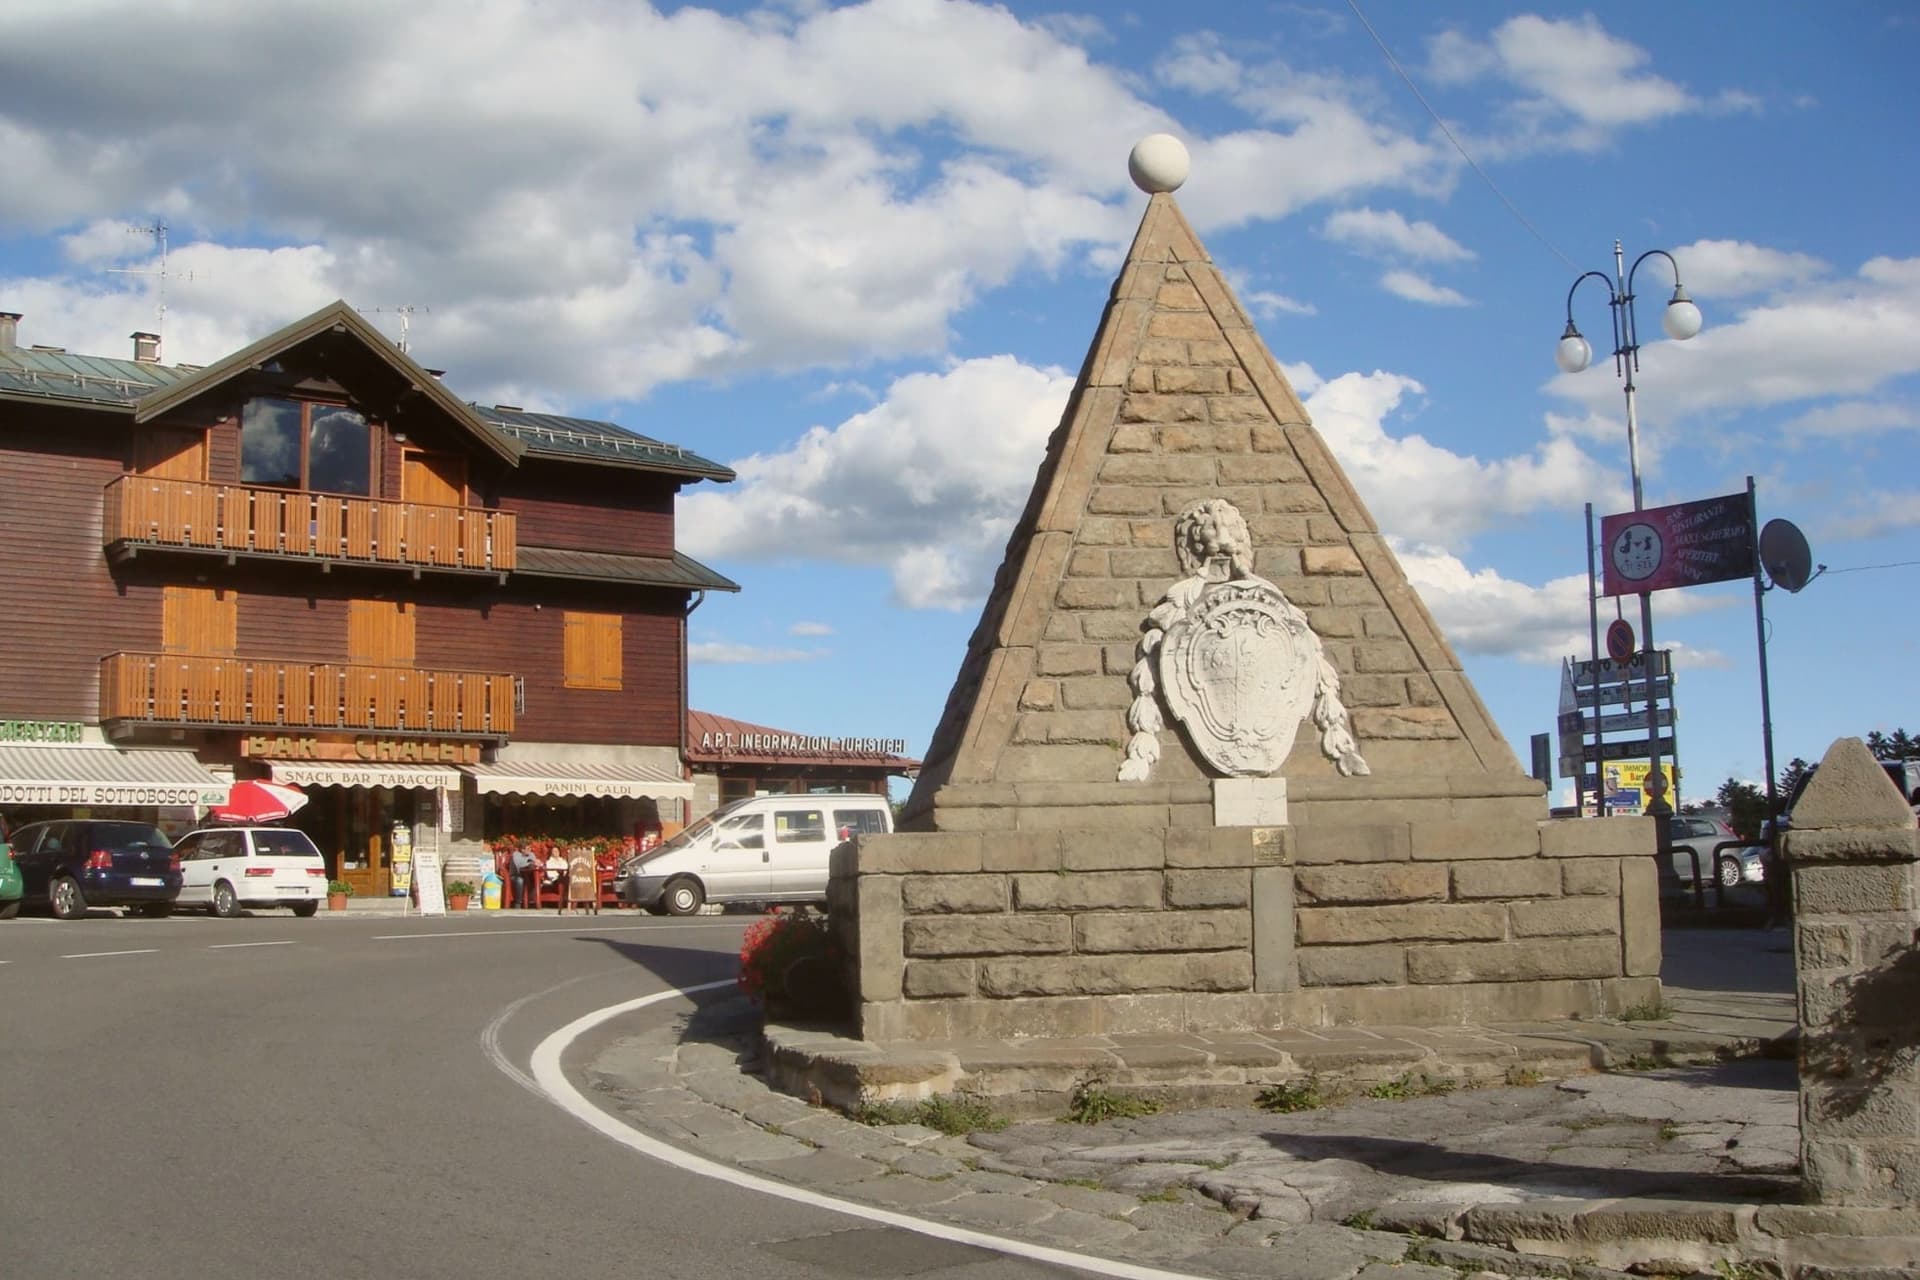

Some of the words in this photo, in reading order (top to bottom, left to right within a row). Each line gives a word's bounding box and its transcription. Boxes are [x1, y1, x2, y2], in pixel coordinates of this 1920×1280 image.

[249, 736, 318, 758] BAR
[285, 770, 334, 784] SNACK
[342, 771, 371, 784] BAR
[380, 773, 449, 786] TABACCHI
[0, 786, 52, 803] DOTTI
[59, 787, 89, 803] DEL
[94, 788, 199, 805] SOTTOBOSCO
[545, 783, 587, 792] PANINI
[595, 784, 632, 794] CALDI
